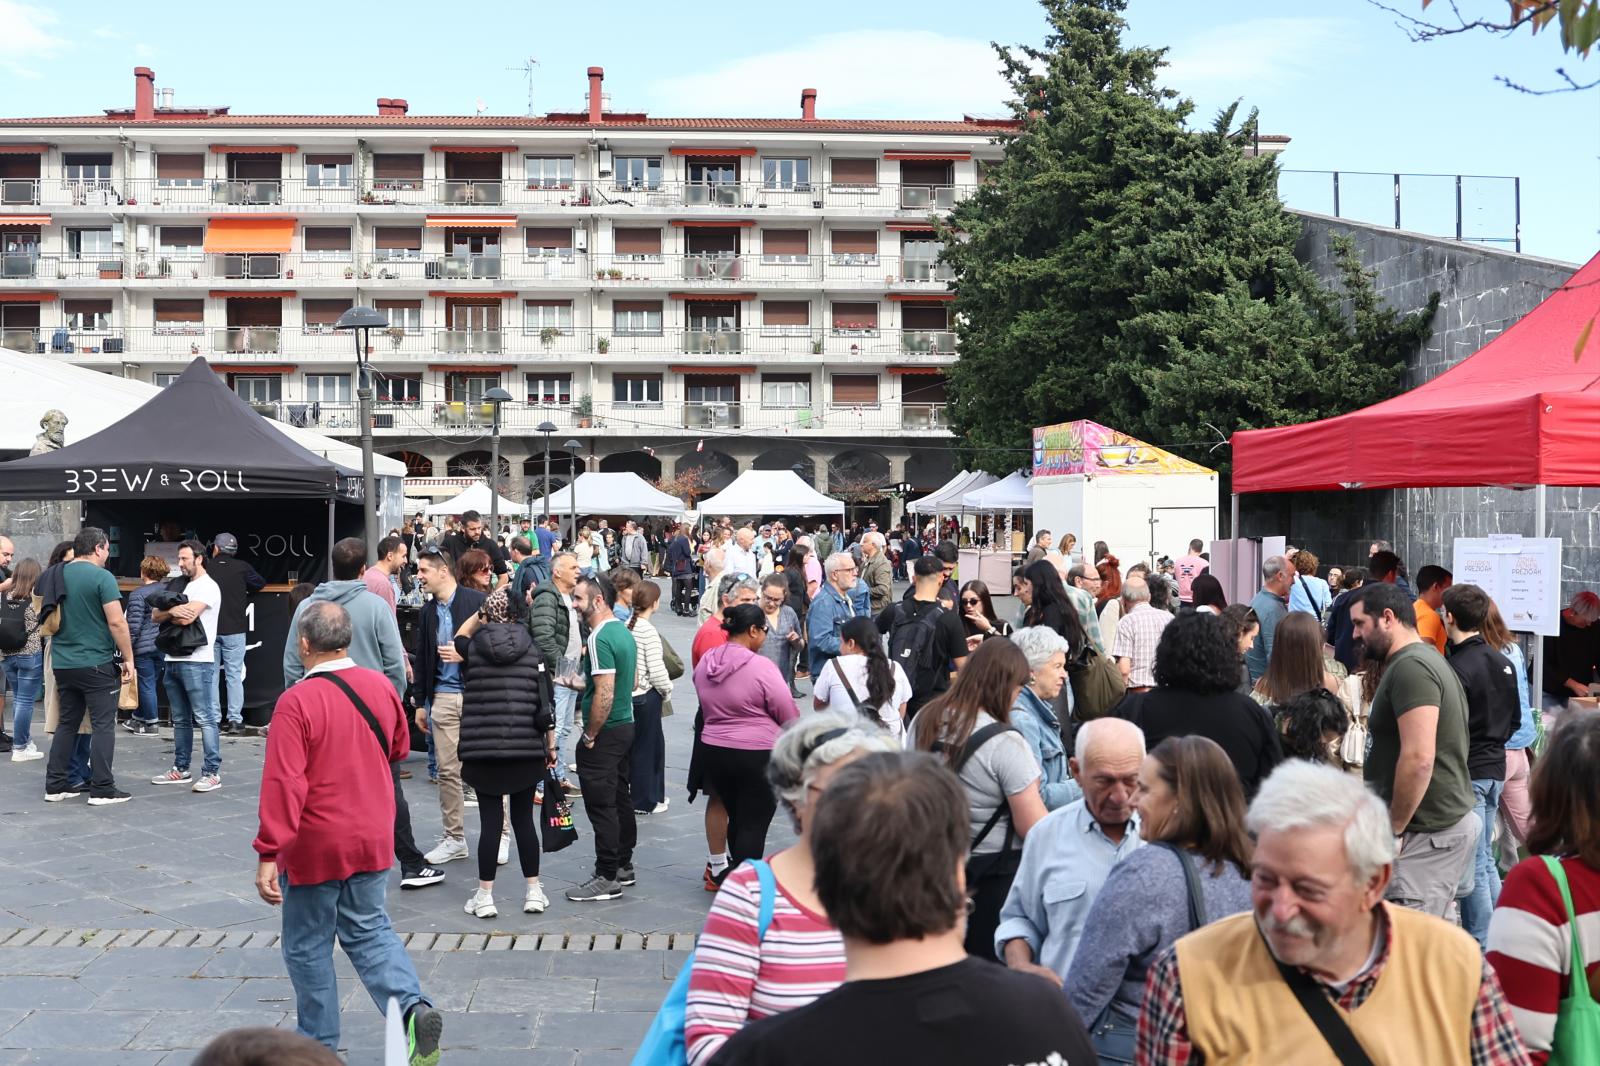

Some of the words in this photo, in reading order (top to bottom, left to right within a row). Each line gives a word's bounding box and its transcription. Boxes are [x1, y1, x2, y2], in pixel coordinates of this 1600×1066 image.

[65, 468, 153, 493] BREW
[160, 473, 169, 486] &
[179, 469, 250, 492] ROLL
[248, 534, 314, 557] ROLL
